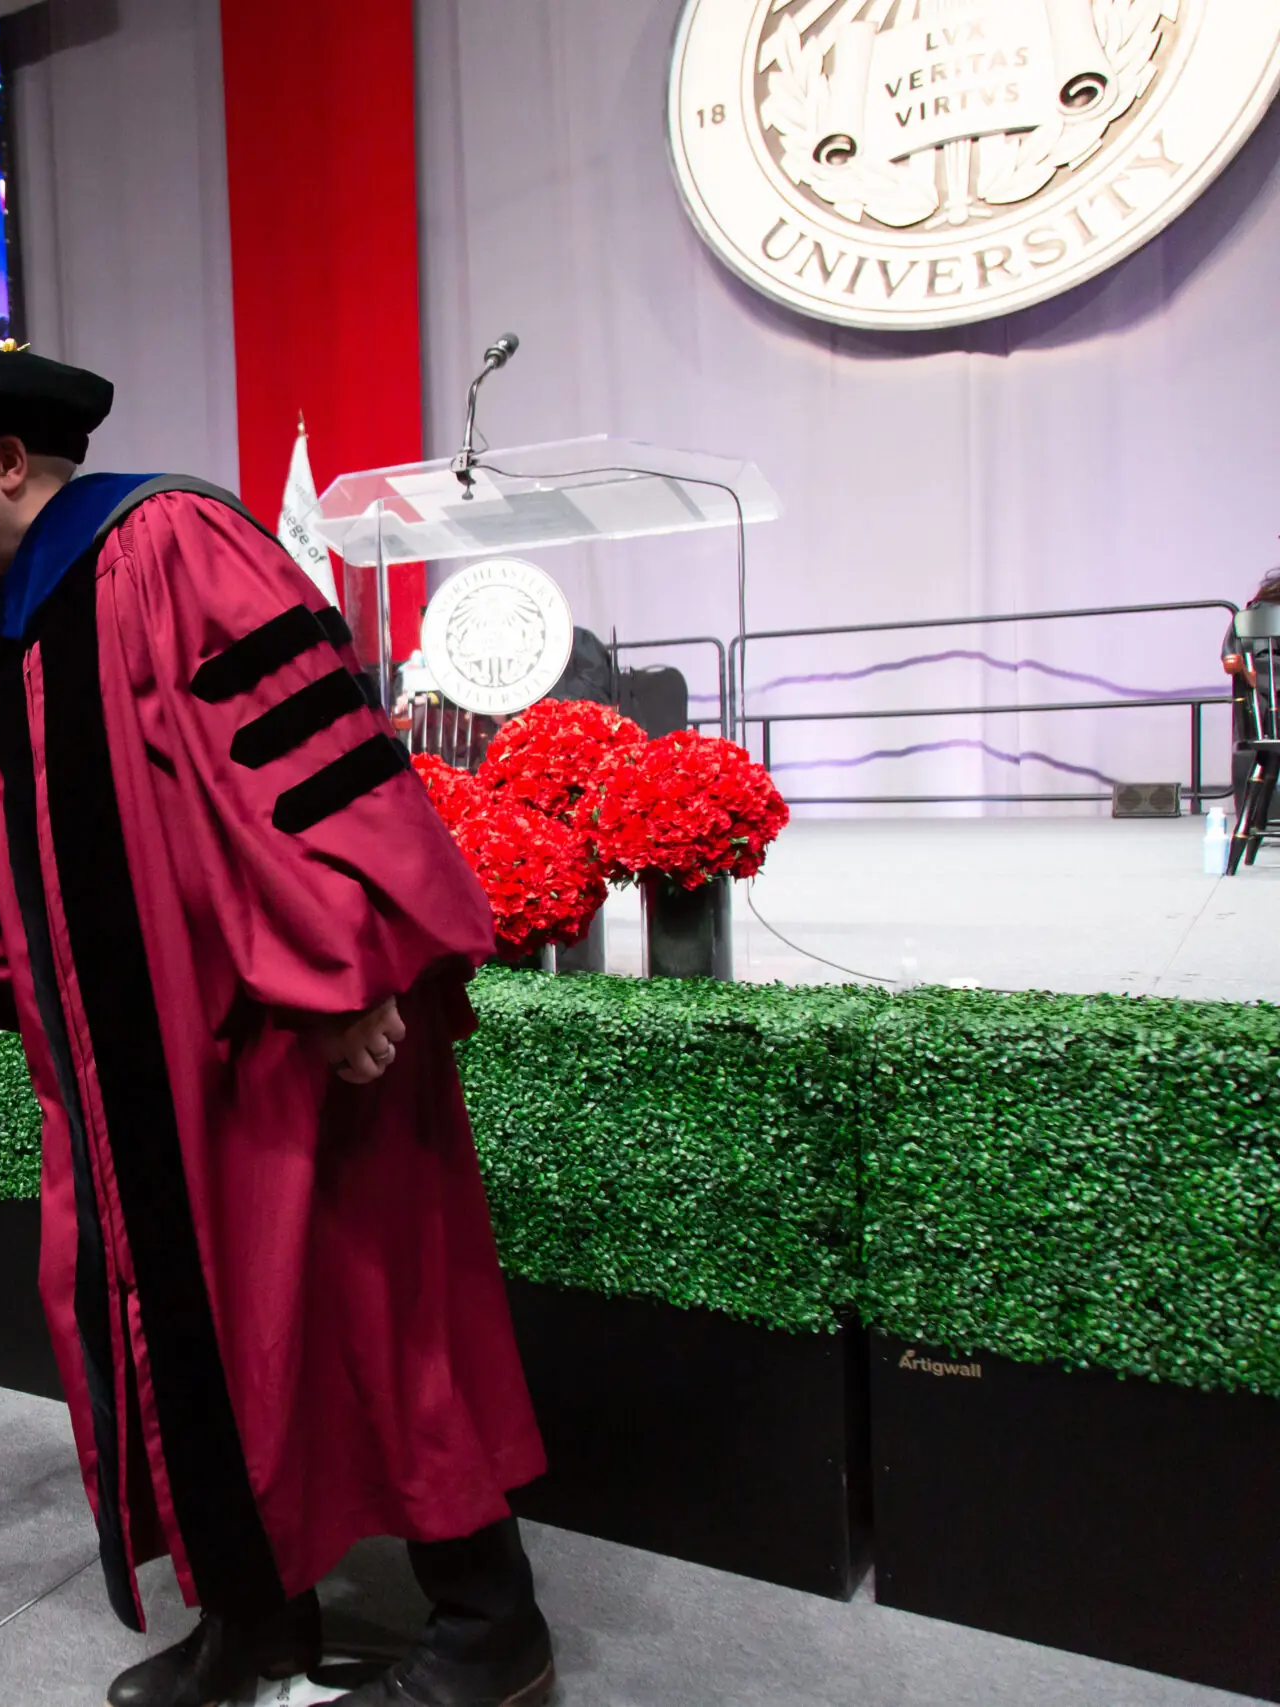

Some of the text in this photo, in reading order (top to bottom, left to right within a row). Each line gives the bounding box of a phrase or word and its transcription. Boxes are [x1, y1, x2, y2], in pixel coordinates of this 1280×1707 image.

[926, 20, 985, 51] LVX
[885, 46, 1029, 98] VERITAS
[696, 103, 726, 129] 18
[895, 83, 1019, 128] VIRTVS
[761, 130, 1185, 299] UNIVERSITY
[308, 546, 327, 564] of
